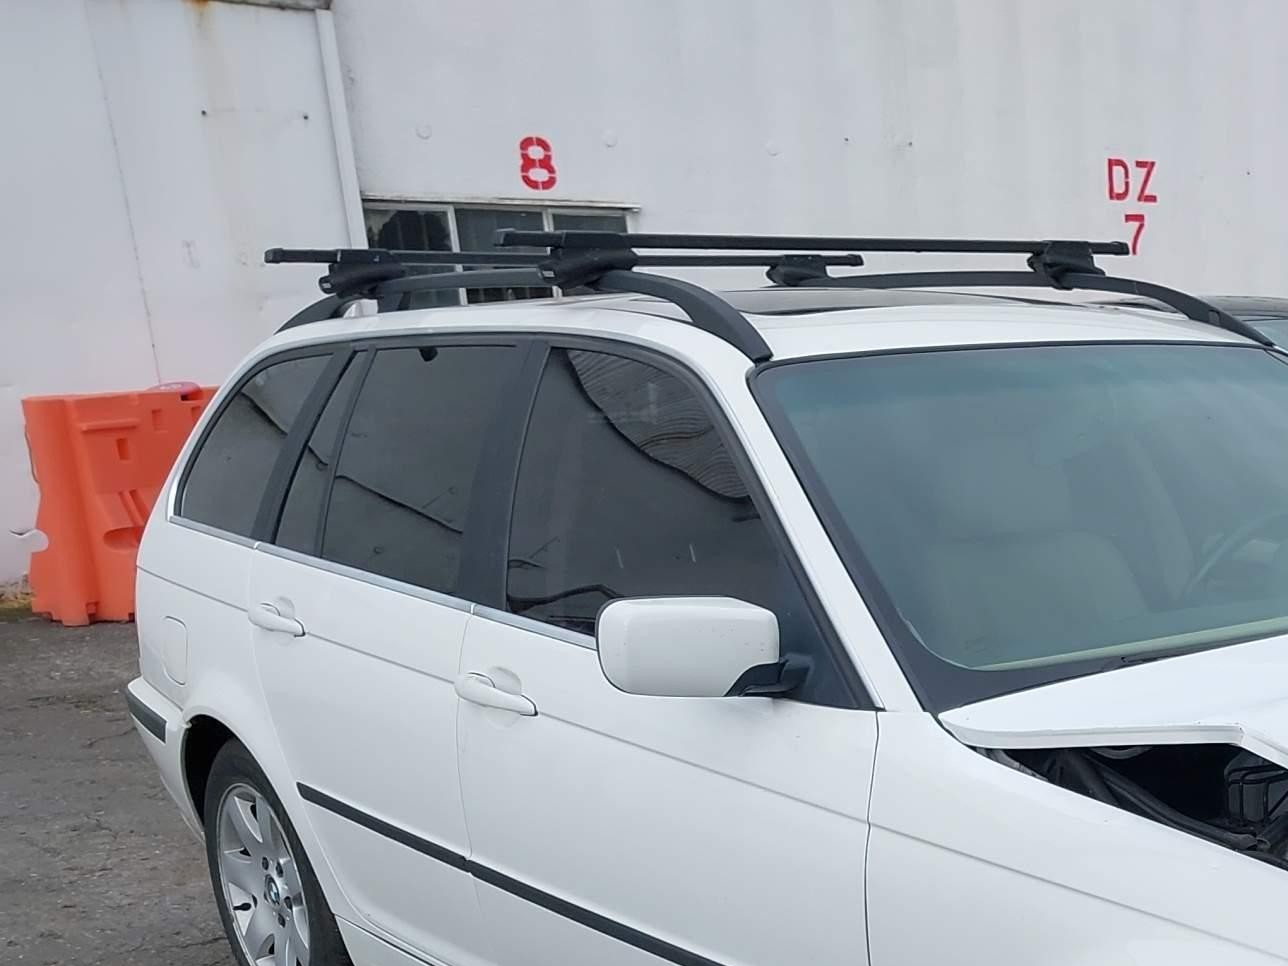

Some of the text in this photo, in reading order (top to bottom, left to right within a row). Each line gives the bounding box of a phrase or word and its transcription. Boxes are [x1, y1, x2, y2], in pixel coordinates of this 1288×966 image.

[519, 136, 557, 191] 8
[1106, 157, 1158, 203] DZ
[1124, 213, 1145, 256] 7
